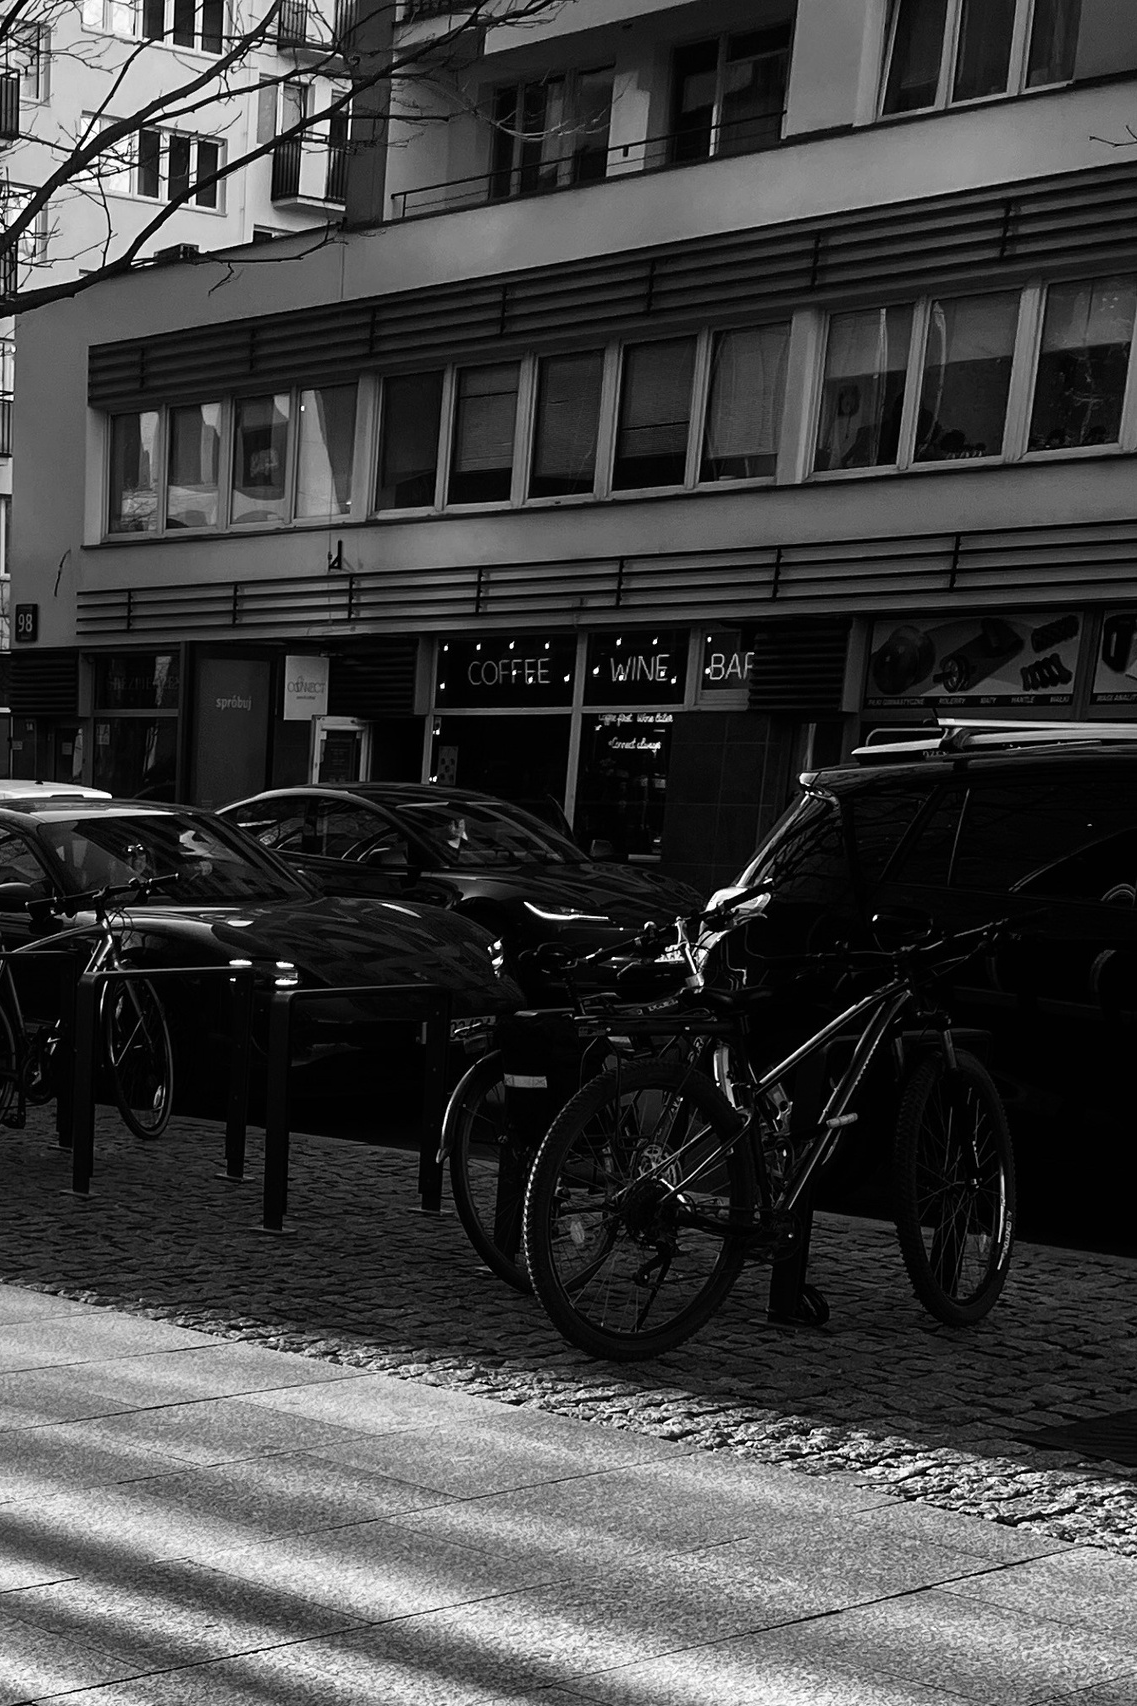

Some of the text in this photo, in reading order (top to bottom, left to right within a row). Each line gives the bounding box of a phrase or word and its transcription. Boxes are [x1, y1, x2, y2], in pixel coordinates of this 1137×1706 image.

[18, 613, 33, 632] 98
[467, 658, 552, 685] COFFEE
[610, 654, 671, 682] WINE
[216, 695, 252, 711] spróbuj
